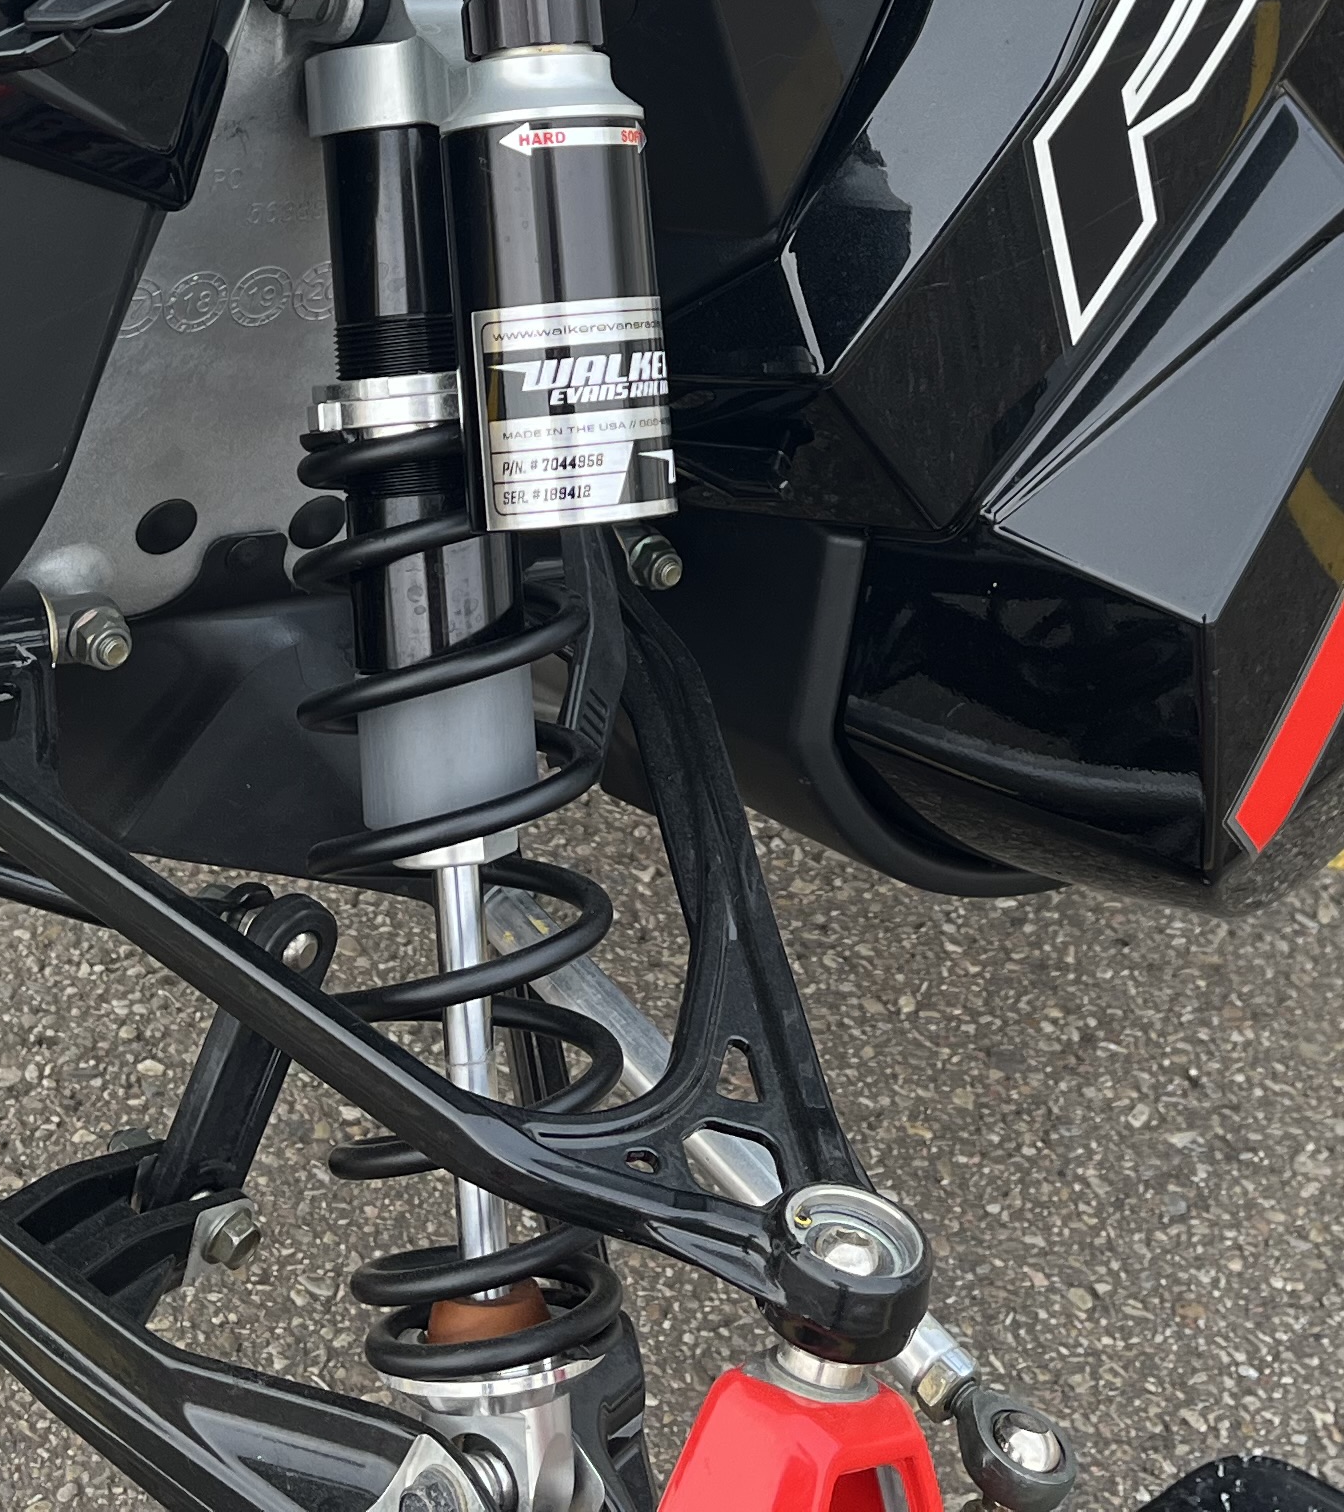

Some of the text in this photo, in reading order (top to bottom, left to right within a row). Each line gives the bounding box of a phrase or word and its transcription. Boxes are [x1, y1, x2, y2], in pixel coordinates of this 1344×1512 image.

[518, 131, 567, 147] HARD
[549, 383, 629, 406] EVANS
[503, 429, 542, 440] MADE
[546, 427, 563, 437] IN
[567, 424, 595, 434] THE
[599, 420, 627, 431] USA
[502, 460, 526, 477] P/N.
[531, 459, 538, 470] #
[503, 489, 528, 506] SER.
